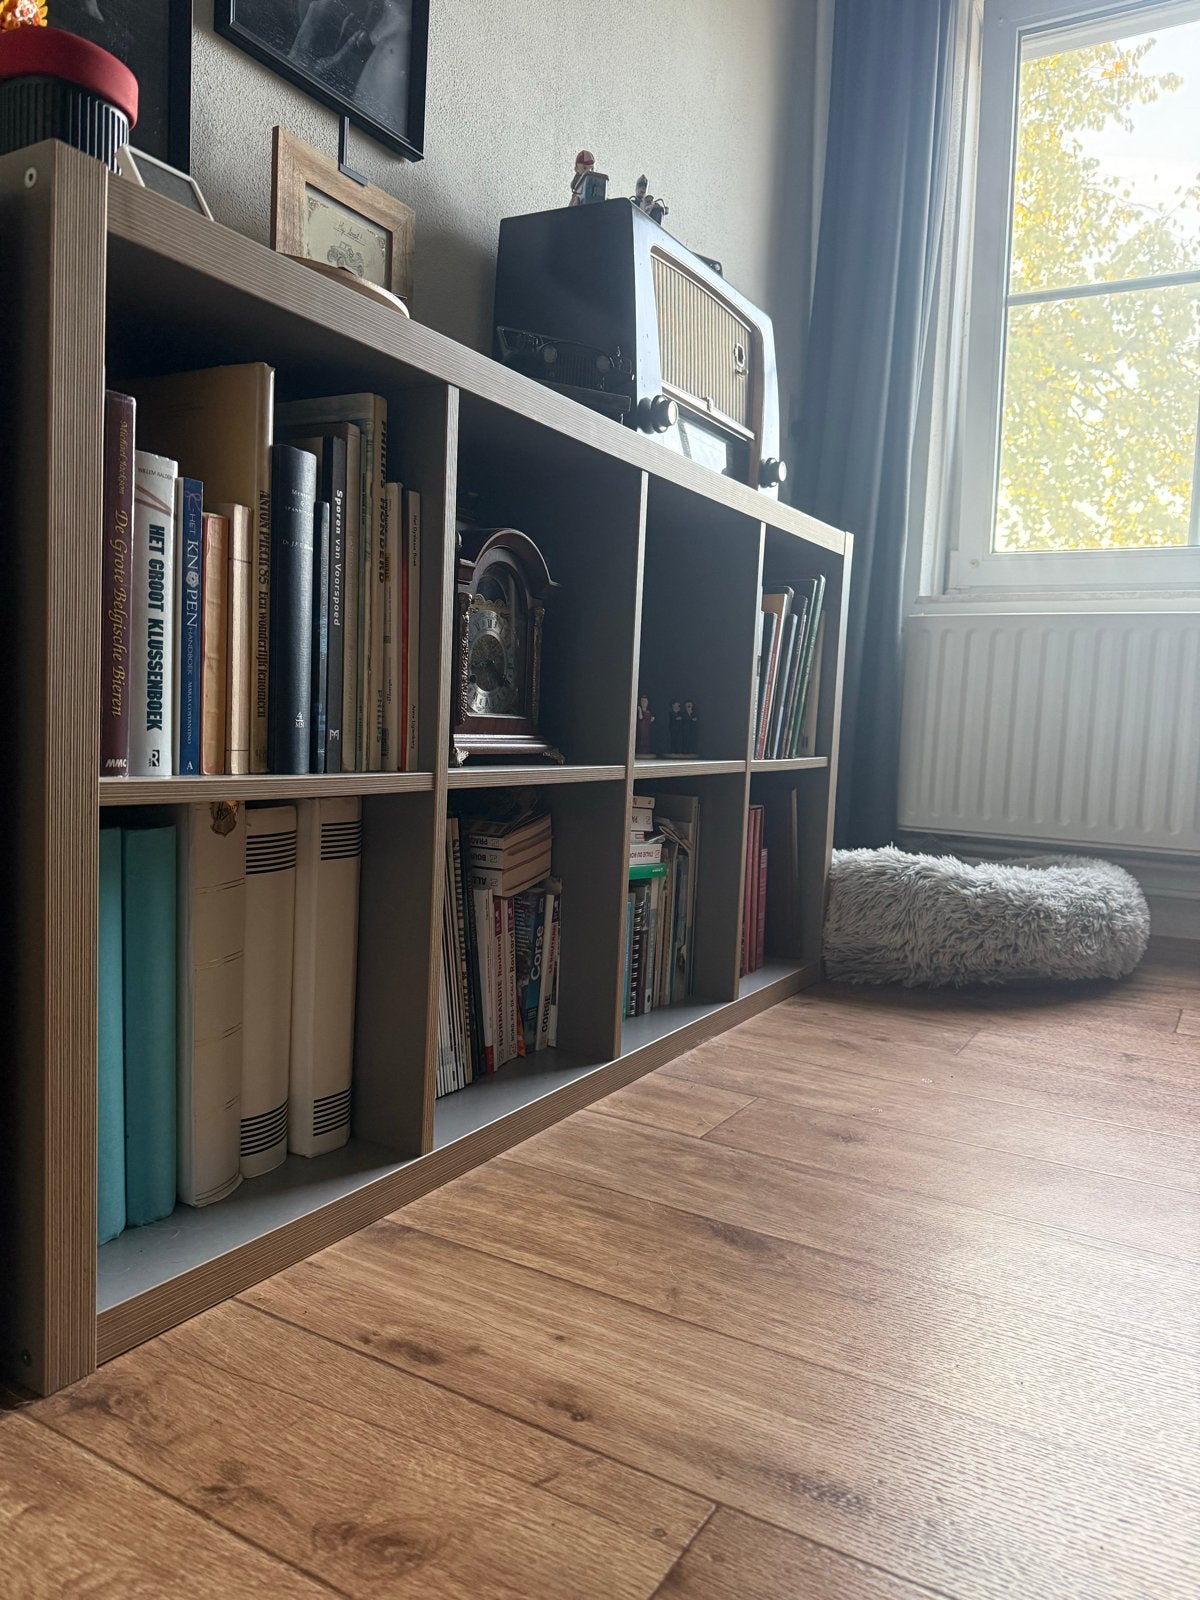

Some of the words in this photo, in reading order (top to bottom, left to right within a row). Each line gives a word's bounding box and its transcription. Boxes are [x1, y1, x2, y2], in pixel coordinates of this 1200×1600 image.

[118, 457, 127, 495] Jackson
[138, 466, 156, 475] WILLEM
[380, 420, 388, 488] PHILIPS
[115, 510, 129, 537] De
[189, 513, 197, 537] HET
[259, 489, 271, 528] ANTON
[334, 489, 344, 534] Sporen
[111, 538, 127, 585] Grote
[149, 524, 165, 555] HET
[377, 497, 387, 585] HONDERD
[148, 558, 165, 612] GROOT
[332, 562, 341, 627] Voorspoed
[110, 588, 126, 662] Belgische
[146, 617, 164, 732] KLUSSENBOEK
[186, 627, 194, 675] HANDBOEK
[111, 664, 126, 718] Bieren
[105, 758, 127, 768] MMC
[530, 925, 544, 981] Corse
[497, 980, 505, 1047] NORMANDIE
[541, 994, 552, 1034] CORSE
